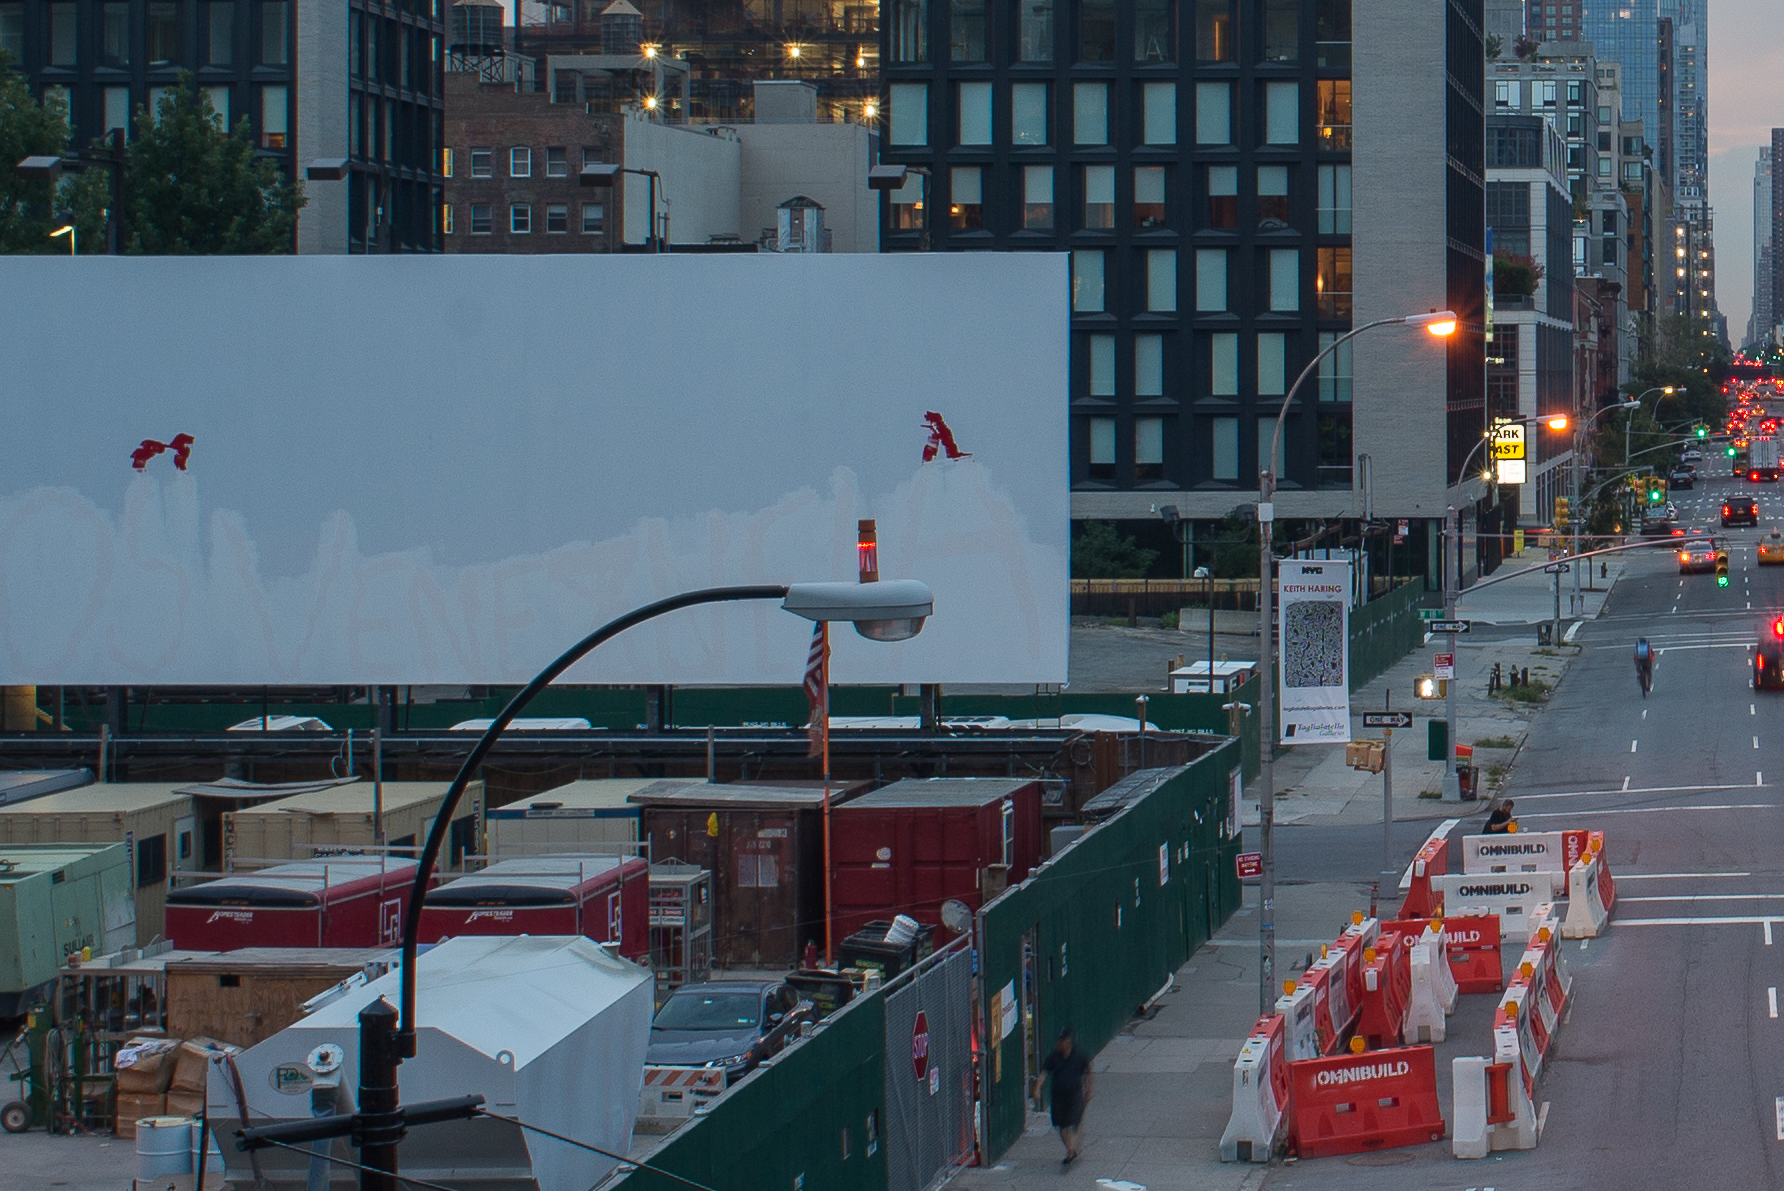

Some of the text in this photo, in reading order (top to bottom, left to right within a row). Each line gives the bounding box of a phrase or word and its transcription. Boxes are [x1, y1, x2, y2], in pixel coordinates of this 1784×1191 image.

[1496, 430, 1519, 439] ARK
[1496, 445, 1519, 454] AST
[1283, 585, 1342, 593] KEITH HARING
[1480, 843, 1545, 857] OMNIBUILD
[1459, 883, 1530, 897] OMNIBUILD
[1317, 1061, 1409, 1086] OMNIBUILD
